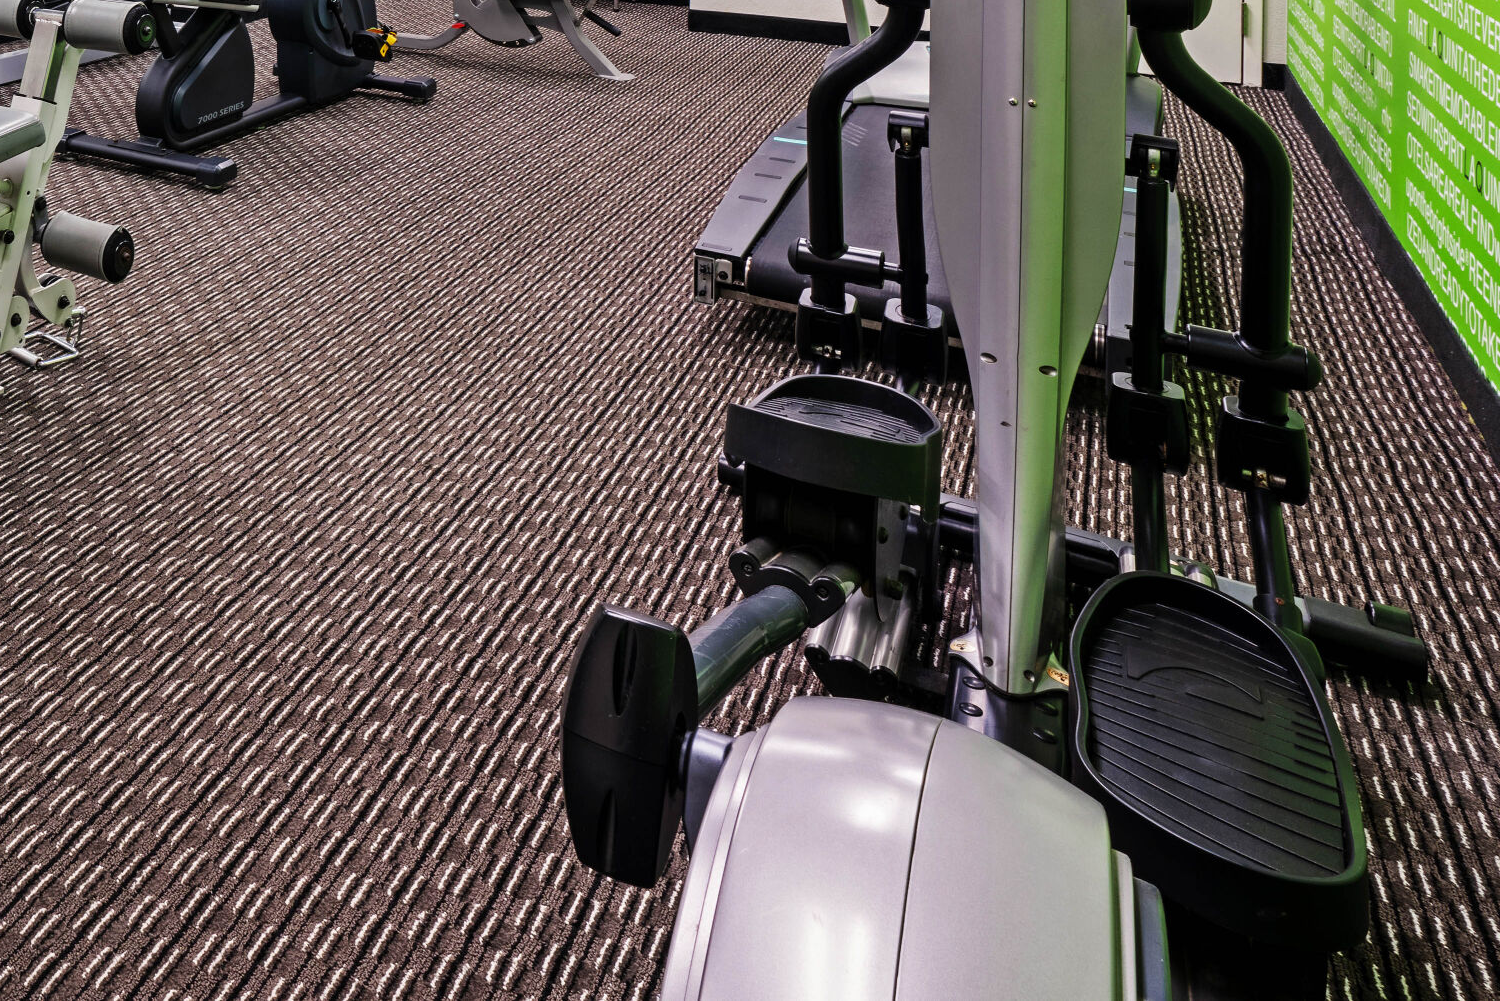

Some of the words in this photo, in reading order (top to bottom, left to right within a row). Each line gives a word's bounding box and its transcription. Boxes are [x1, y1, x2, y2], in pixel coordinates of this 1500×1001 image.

[197, 111, 218, 125] 7000
[219, 100, 244, 117] SERIES
[1408, 50, 1500, 161] SMAKEITMEMORABLEI
